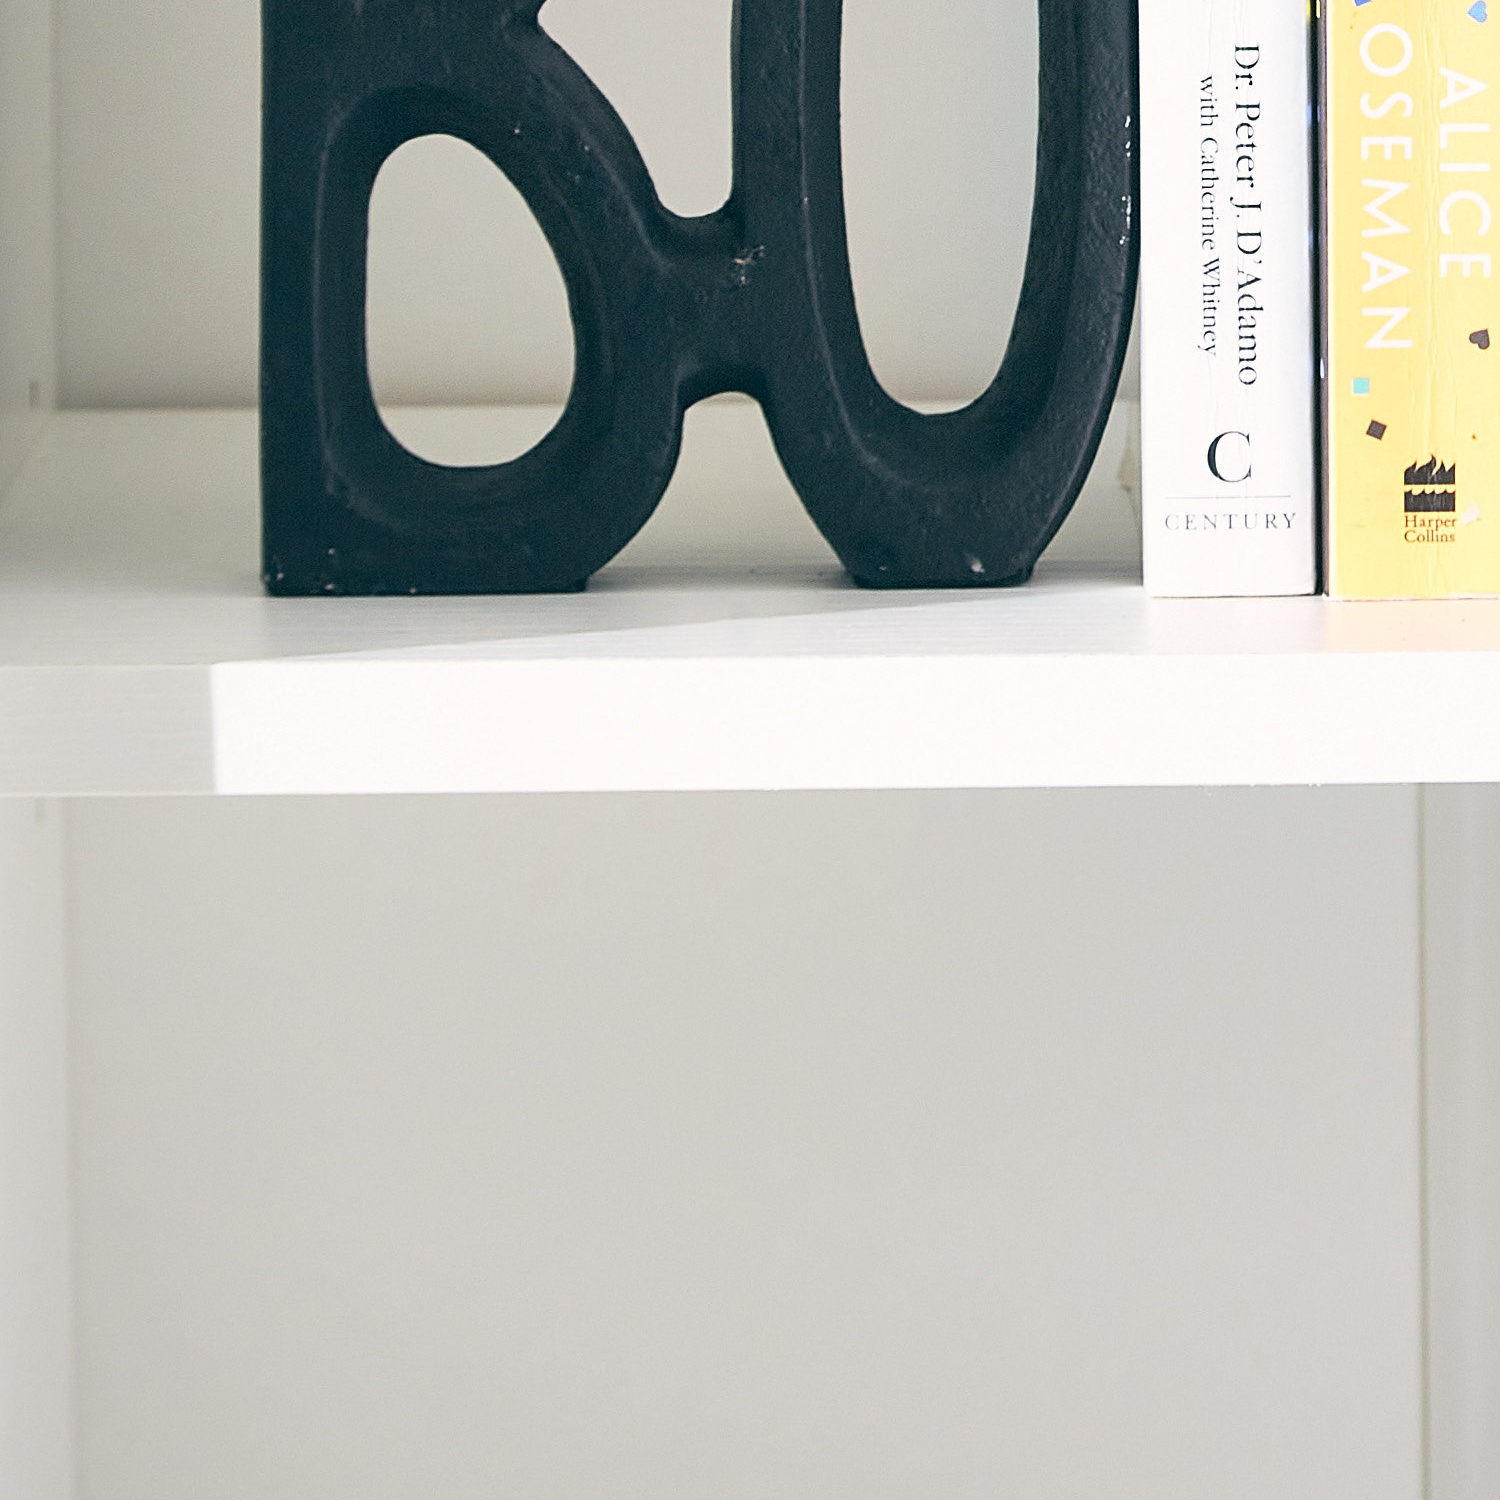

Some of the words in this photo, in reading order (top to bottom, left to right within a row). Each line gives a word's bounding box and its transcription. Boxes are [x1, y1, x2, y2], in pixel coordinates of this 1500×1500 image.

[1200, 74, 1218, 126] with
[1234, 44, 1260, 90] Dr.
[1235, 102, 1261, 188] Peter
[1439, 67, 1491, 277] ALICE
[1201, 137, 1219, 251] Catherine
[1229, 196, 1262, 218] J.
[1360, 23, 1413, 349] OSEMAN
[1198, 257, 1220, 355] Whitney
[1236, 230, 1264, 386] D'Adamo
[1165, 512, 1296, 531] CENTURY
[1405, 515, 1456, 531] Harper
[1405, 529, 1455, 543] Collins
